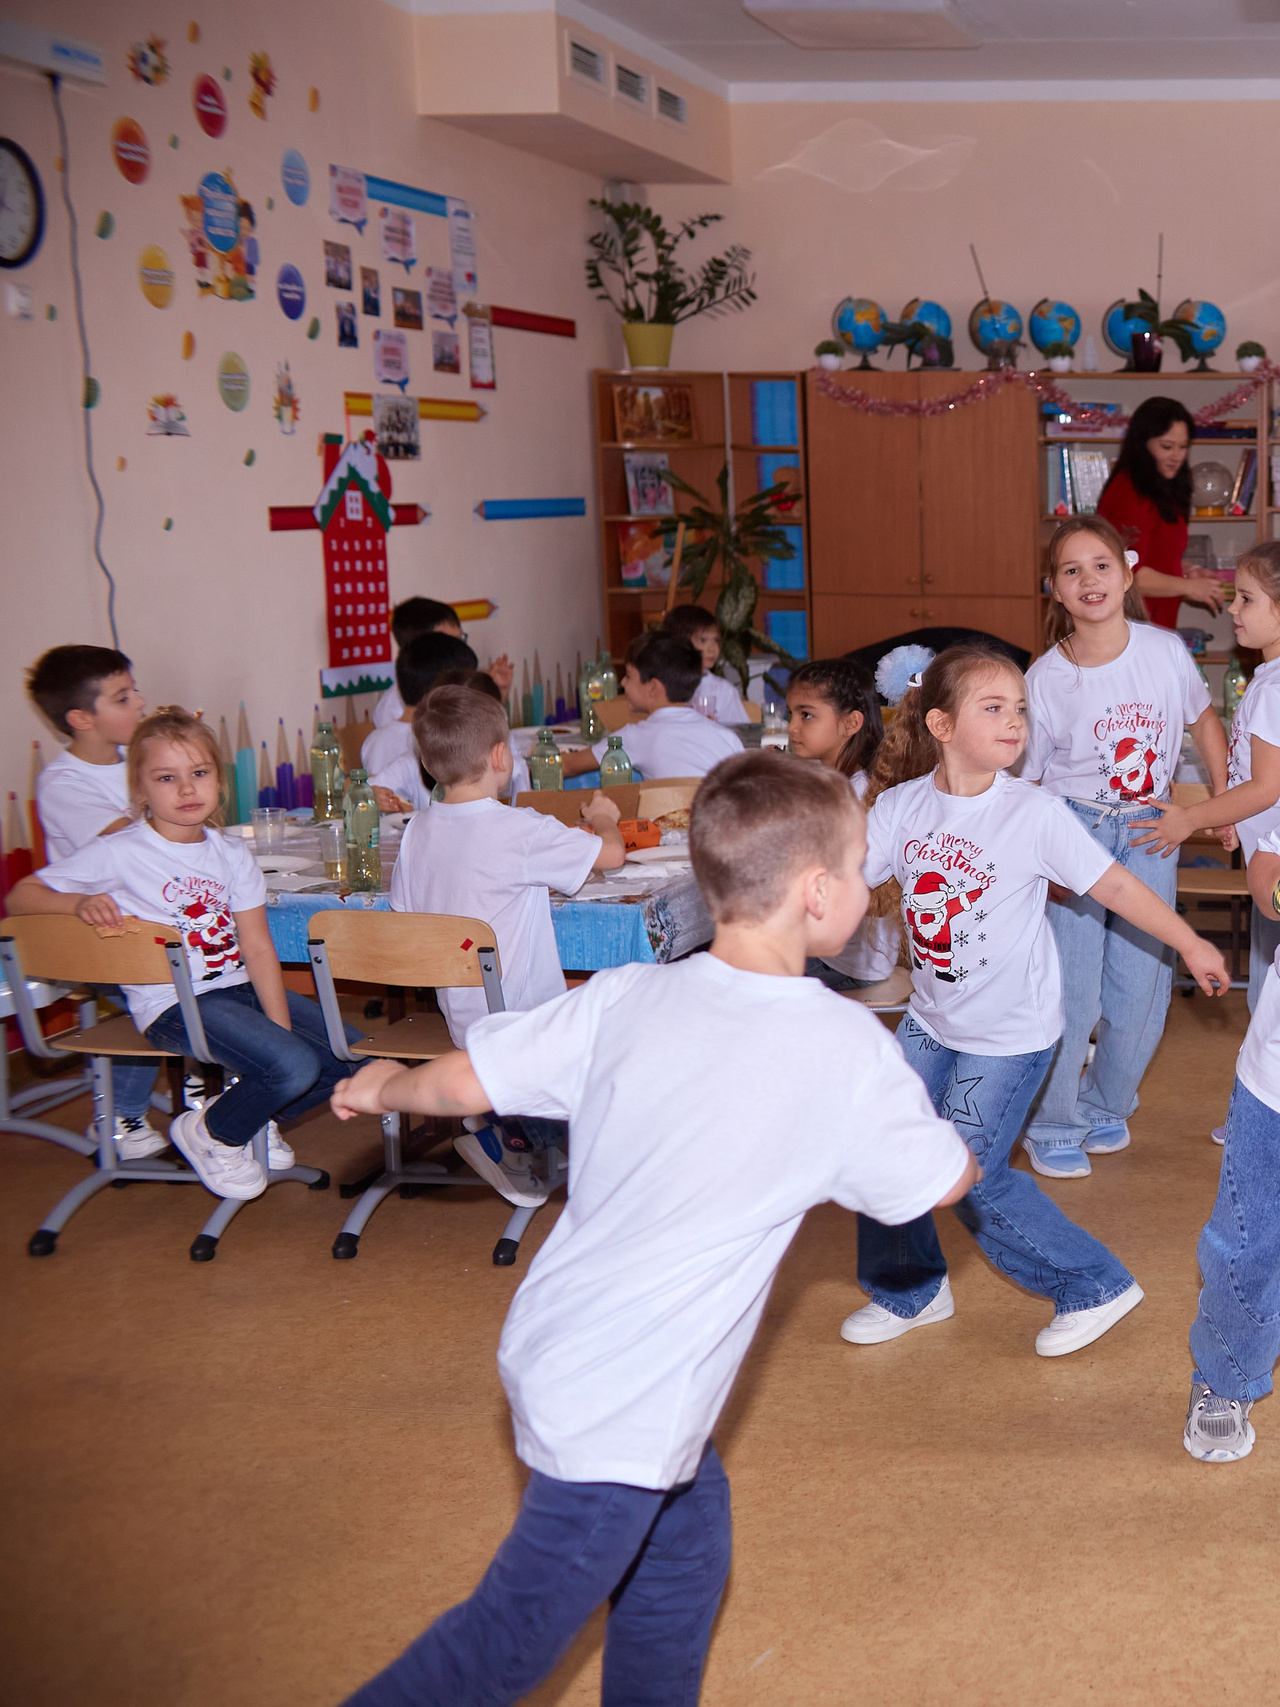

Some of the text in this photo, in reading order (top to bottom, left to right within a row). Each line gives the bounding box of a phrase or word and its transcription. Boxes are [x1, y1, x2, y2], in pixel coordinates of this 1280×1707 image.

[1115, 702, 1153, 716] Merry
[936, 832, 984, 859] Merry
[904, 839, 997, 891] Christmas
[183, 876, 226, 895] Merry
[919, 1038, 942, 1052] NO
